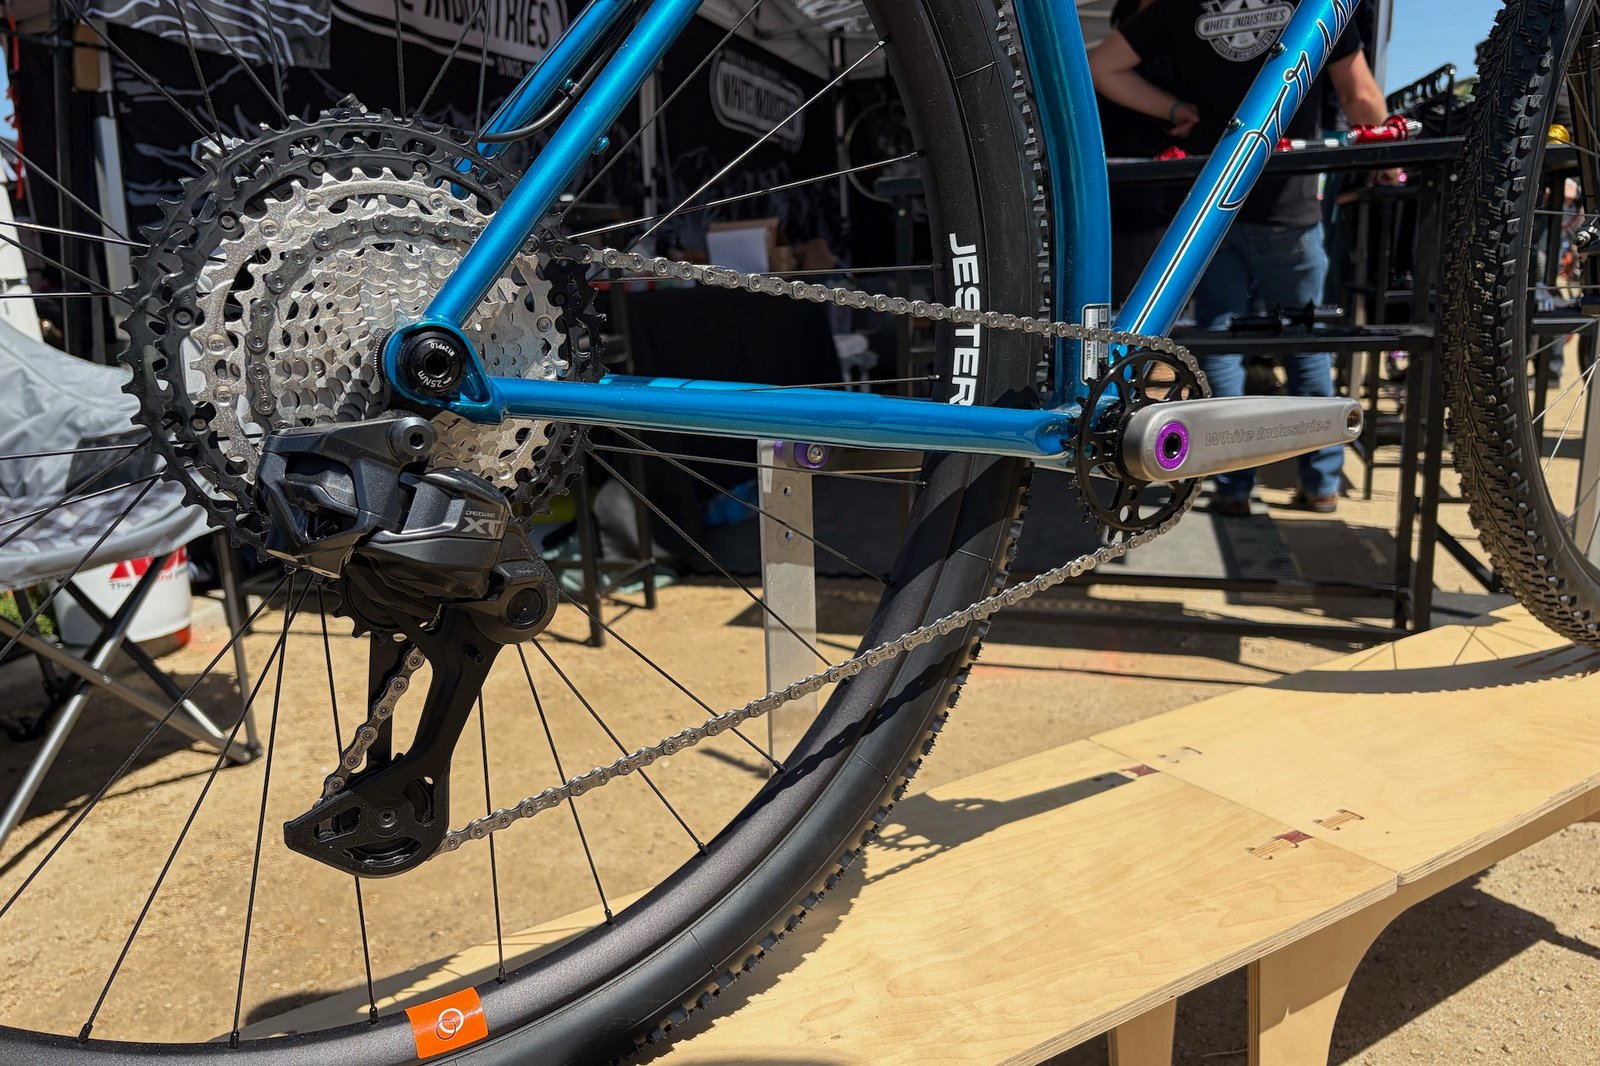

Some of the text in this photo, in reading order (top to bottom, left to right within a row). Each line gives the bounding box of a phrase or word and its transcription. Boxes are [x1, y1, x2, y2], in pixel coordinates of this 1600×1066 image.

[949, 233, 981, 406] JESTER
[417, 370, 443, 388] 25Nm
[1204, 428, 1254, 447] White
[1256, 418, 1332, 441] Industries
[465, 507, 496, 518] DEORE
[460, 516, 505, 539] XT
